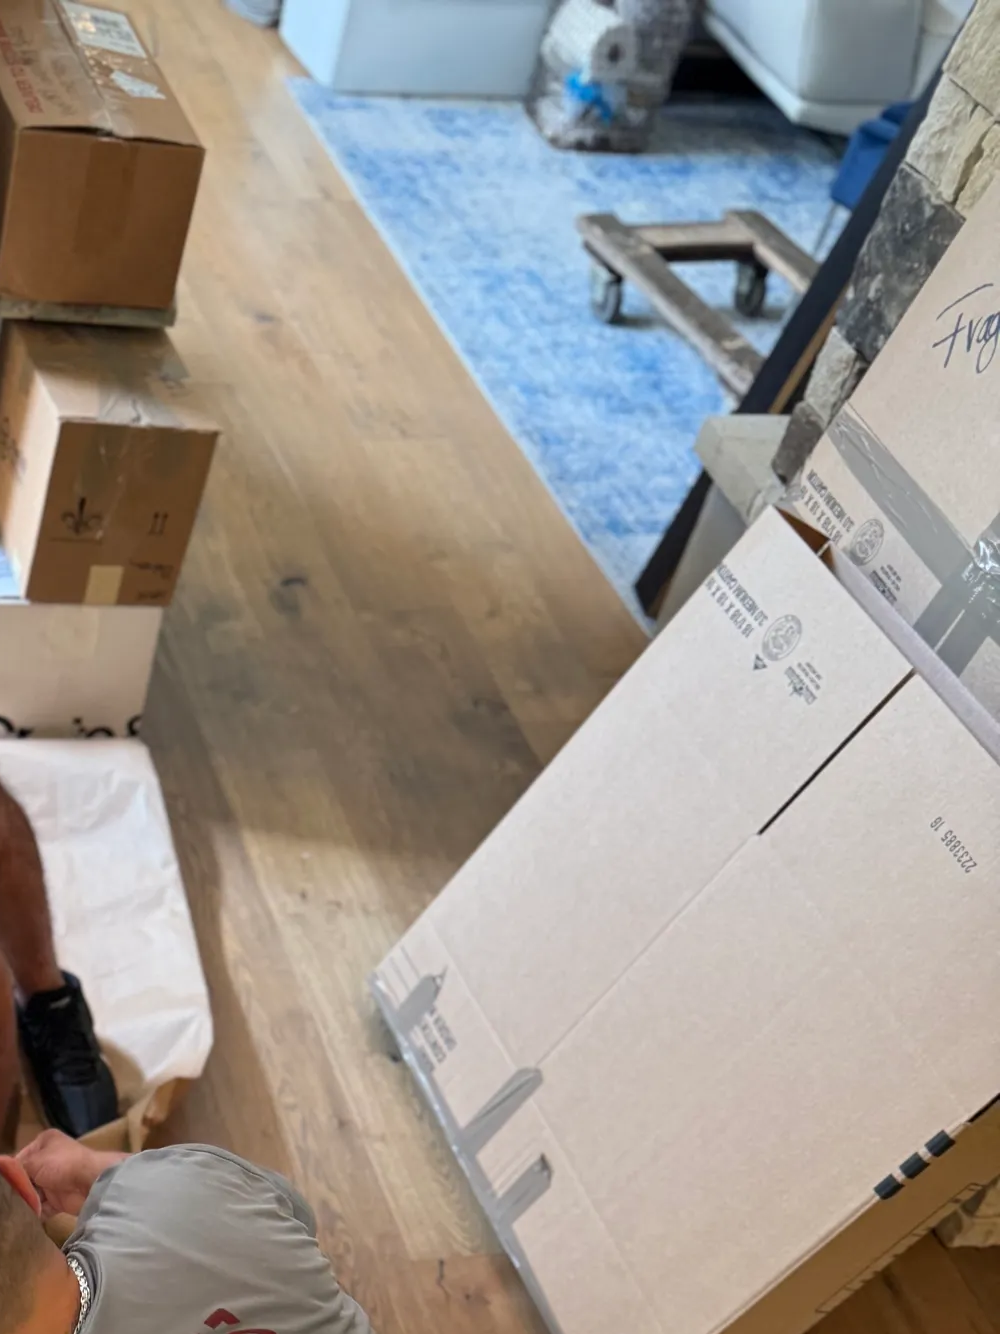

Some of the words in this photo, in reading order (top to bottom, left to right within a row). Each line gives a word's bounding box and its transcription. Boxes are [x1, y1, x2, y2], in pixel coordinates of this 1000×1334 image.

[732, 583, 760, 617] MEDIUM
[930, 816, 945, 832] 16
[941, 829, 978, 874] 2233885
